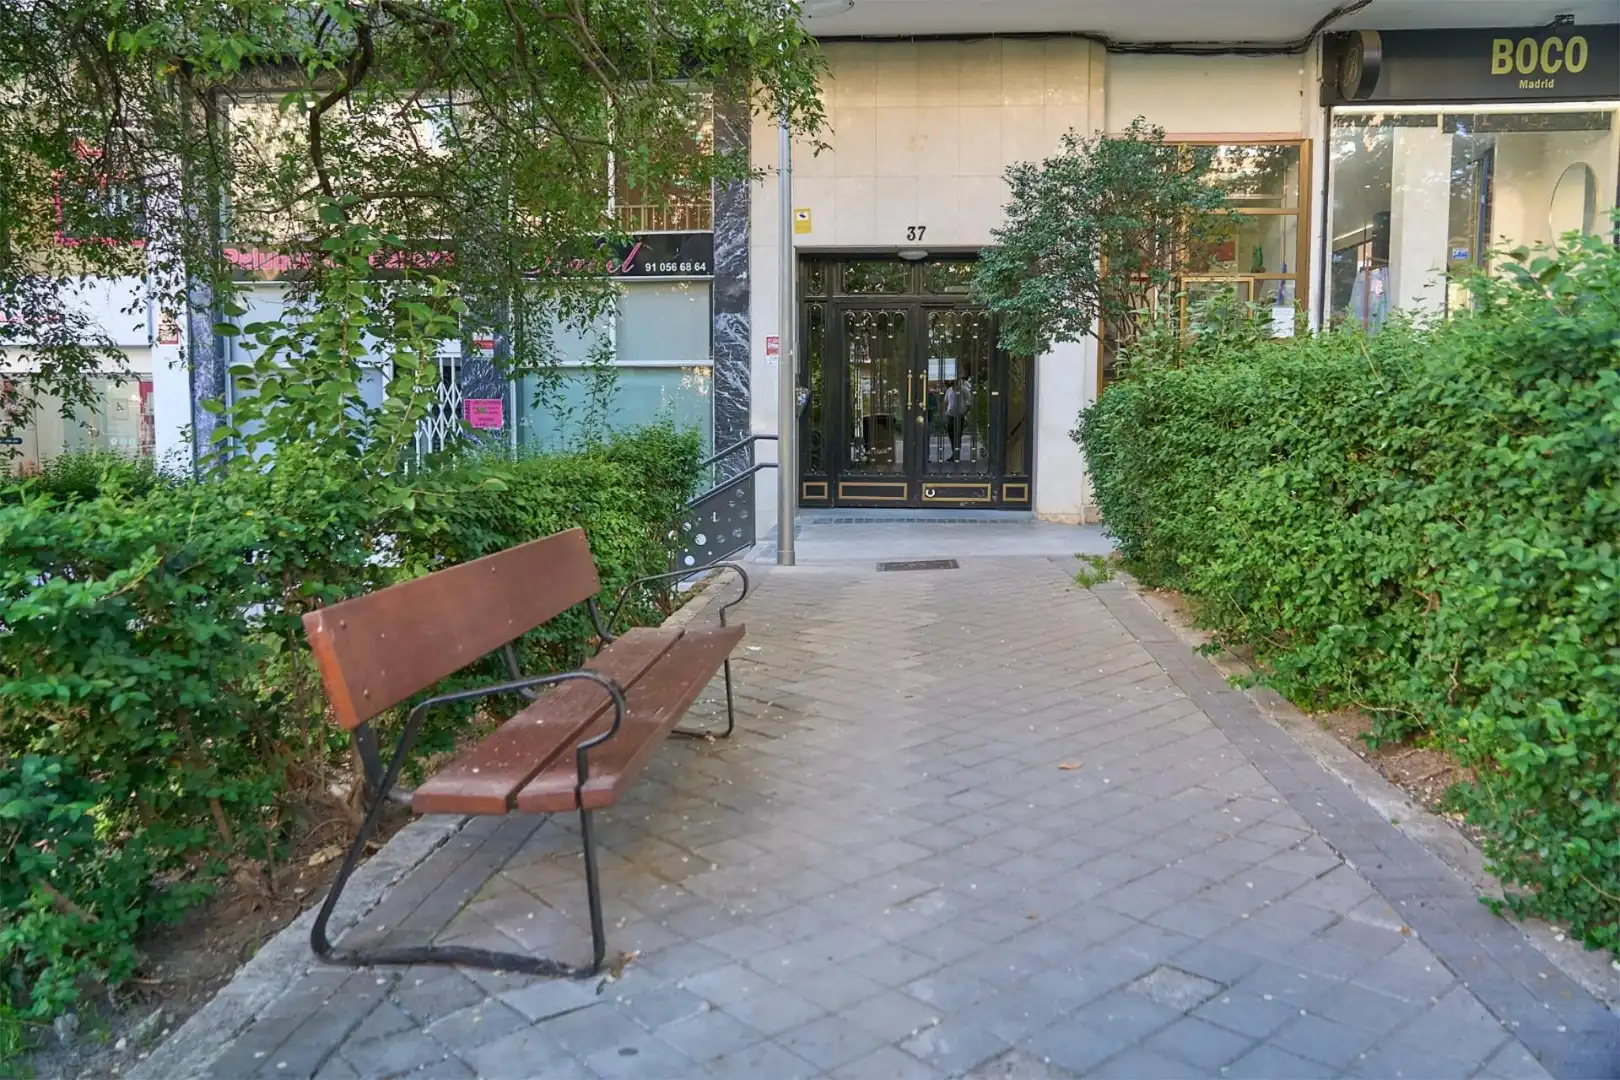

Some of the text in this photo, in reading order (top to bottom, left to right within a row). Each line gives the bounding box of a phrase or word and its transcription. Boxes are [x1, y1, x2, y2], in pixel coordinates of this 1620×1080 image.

[1491, 36, 1588, 74] BOCO
[1519, 79, 1555, 89] Madrid
[907, 226, 926, 241] 37
[645, 262, 706, 272] 91 056 68 64
